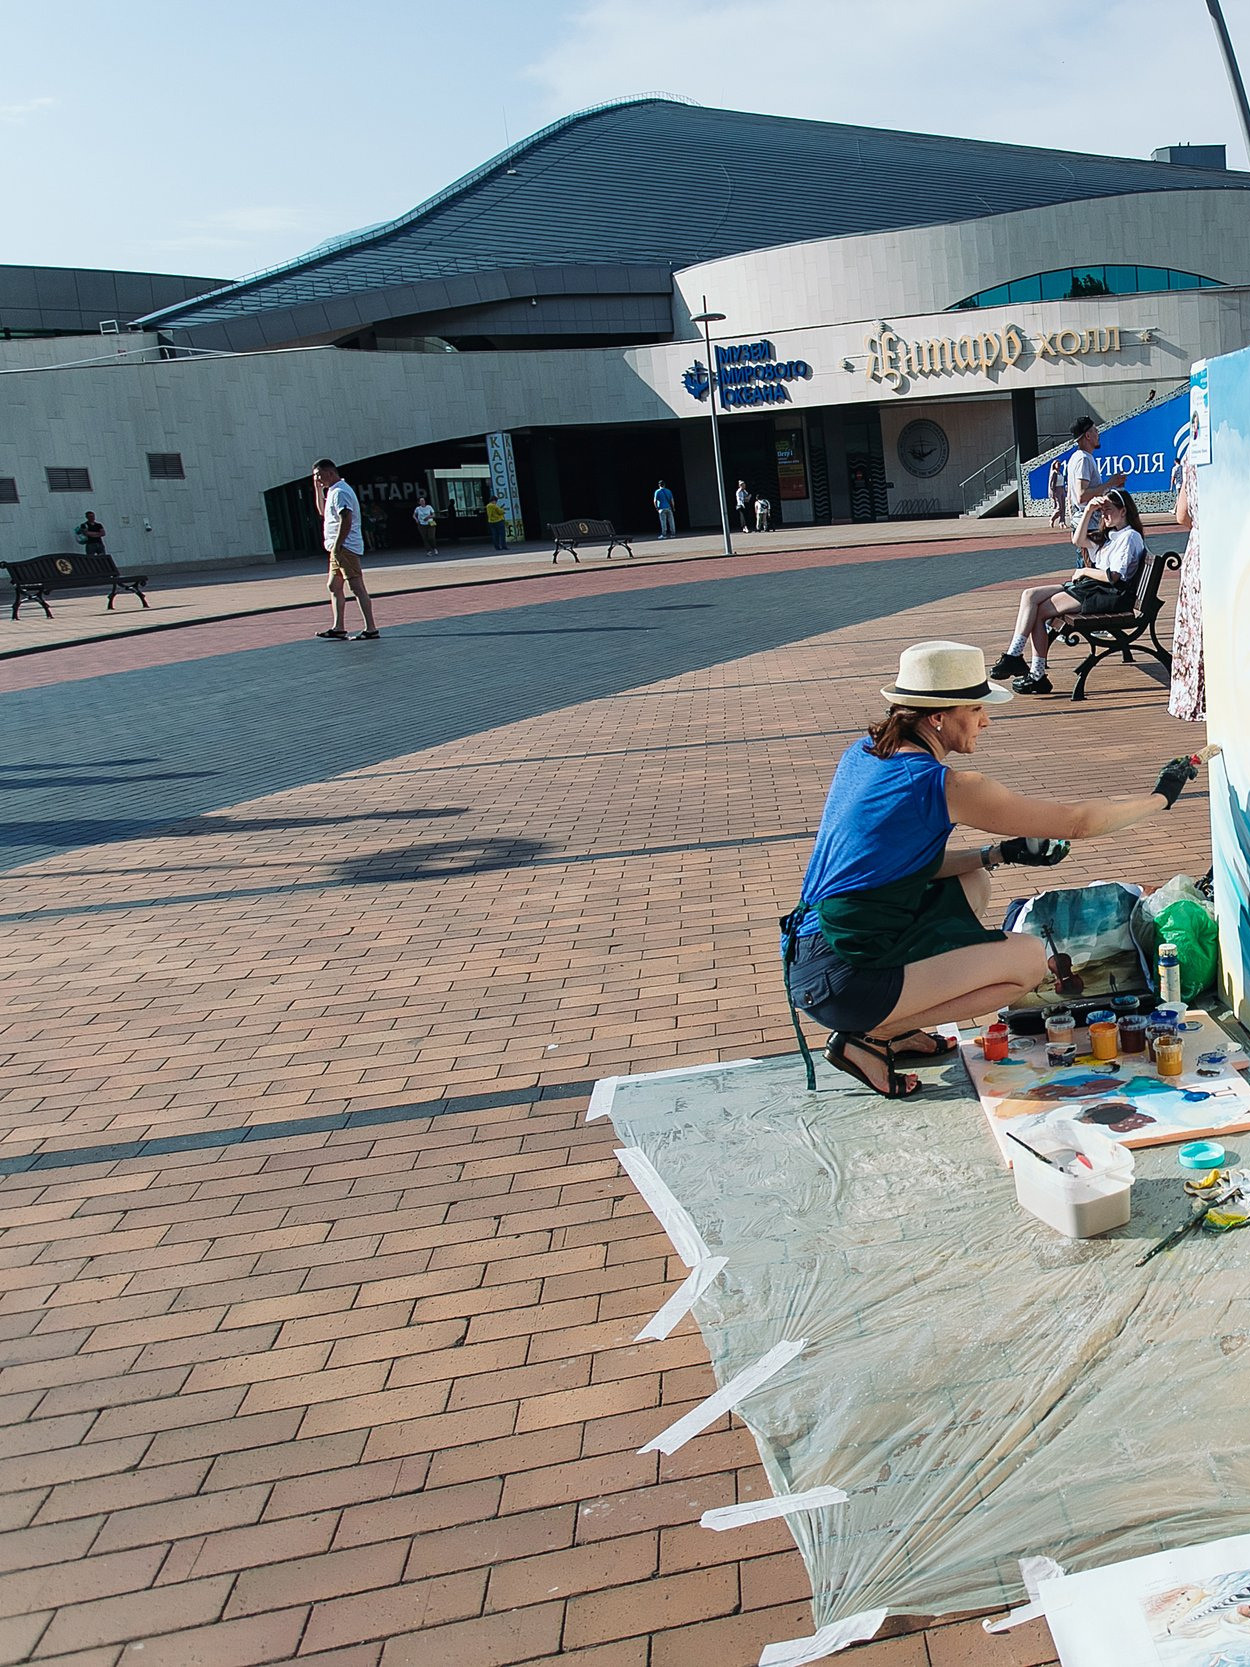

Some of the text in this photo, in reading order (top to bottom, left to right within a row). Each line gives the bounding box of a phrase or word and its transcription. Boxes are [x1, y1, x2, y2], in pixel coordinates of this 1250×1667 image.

[718, 339, 773, 364] МУЗЕЙ
[721, 360, 809, 386] МИРОВОГО
[724, 384, 787, 405] ОКЕАНА
[489, 436, 509, 500] КАССЫ
[1096, 452, 1165, 477] ИЮЛЯ
[357, 481, 428, 501] НТАРЬ
